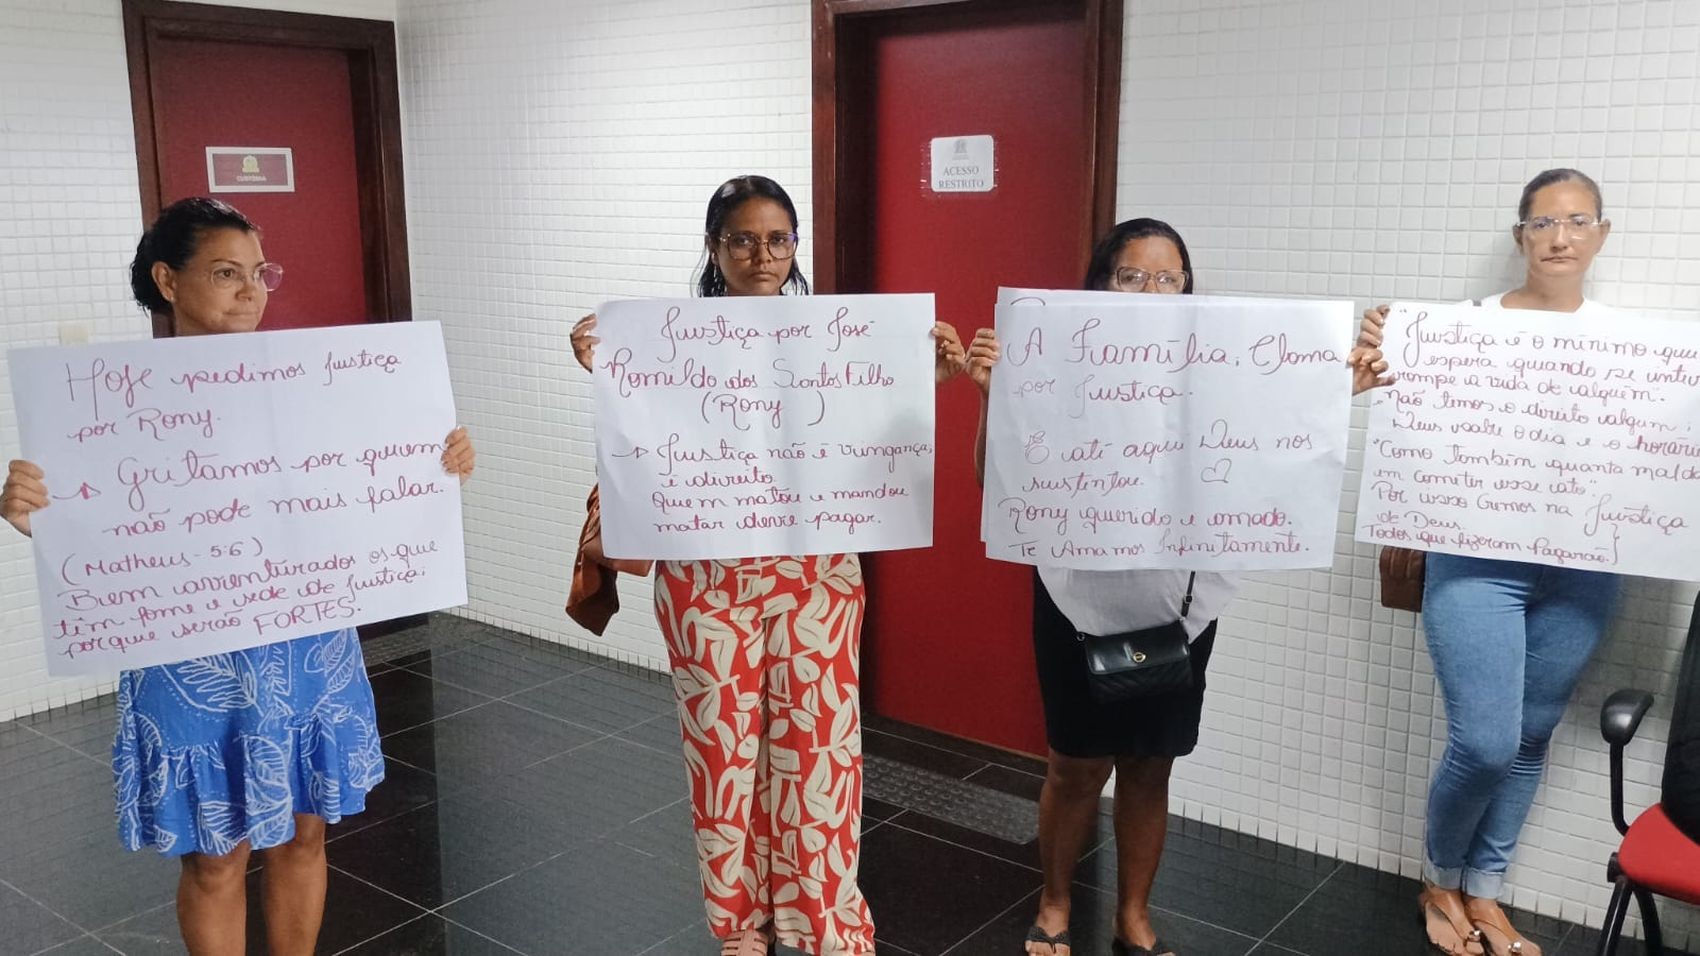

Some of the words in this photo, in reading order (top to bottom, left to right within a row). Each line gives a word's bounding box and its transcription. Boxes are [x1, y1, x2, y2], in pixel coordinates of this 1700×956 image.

[938, 179, 984, 188] RESTRITO
[943, 166, 980, 176] ACESSO
[657, 306, 764, 363] Justiça
[768, 324, 812, 345] por
[827, 306, 875, 352] José
[1006, 326, 1042, 366] A
[1505, 330, 1527, 346] é
[1553, 334, 1648, 357] mínimo
[600, 347, 717, 398] Romildo
[725, 369, 758, 389] dos
[772, 358, 842, 389] Santos
[846, 361, 895, 387] Filho
[1392, 371, 1456, 390] rompe
[1464, 375, 1480, 388] a
[1485, 375, 1530, 391] vida
[1537, 379, 1561, 396] de
[1424, 355, 1497, 371] espera
[1506, 358, 1597, 379] quando
[1603, 368, 1636, 380] se
[66, 358, 152, 421] Hoje
[171, 363, 306, 393] pedimos
[1013, 377, 1056, 397] por
[1068, 374, 1193, 419] Justiça.
[1433, 391, 1494, 411] temos
[1498, 402, 1516, 413] o
[1521, 401, 1590, 424] direito
[67, 422, 119, 443] por
[126, 407, 221, 441] Rony.
[1061, 438, 1113, 462] até
[1123, 439, 1184, 464] aqui
[1200, 419, 1259, 450] Deus
[1276, 433, 1313, 450] nos
[1392, 412, 1443, 432] Deus
[1451, 418, 1503, 437] sabe
[1528, 428, 1565, 444] dia
[1576, 438, 1591, 446] e
[1602, 439, 1620, 450] o
[657, 432, 758, 476] Justiça
[767, 442, 807, 460] não
[812, 443, 830, 459] é
[1545, 459, 1624, 476] quanta
[117, 449, 282, 512] Gritamos
[291, 452, 347, 473] por
[356, 443, 446, 476] quem
[661, 474, 679, 488] é
[1373, 469, 1404, 481] em
[1494, 479, 1542, 492] esse
[102, 508, 170, 536] não
[178, 498, 251, 533] pode
[268, 488, 347, 514] mais
[356, 475, 445, 513] falar.
[652, 491, 729, 515] Quem
[734, 486, 801, 506] matou
[810, 493, 825, 502] e
[831, 483, 909, 500] mandou
[997, 496, 1069, 536] Rony
[1079, 505, 1172, 534] querido
[1180, 513, 1195, 526] e
[1207, 507, 1292, 528] amado.
[1371, 480, 1408, 503] Por
[1419, 487, 1468, 508] isso
[1545, 503, 1574, 517] na
[1583, 493, 1688, 536] Justiça
[653, 514, 725, 533] matar
[736, 512, 799, 530] deve
[805, 511, 881, 535] pagar.
[1377, 511, 1400, 525] de
[1008, 539, 1041, 557] Te
[1154, 527, 1309, 557] Infinitamente.
[1361, 524, 1412, 541] Todos
[1416, 530, 1447, 548] que
[1451, 531, 1522, 551] fizeram
[57, 585, 163, 612] Bem
[369, 547, 388, 563] os
[391, 540, 438, 568] que
[130, 603, 193, 628] fome
[206, 599, 221, 611] e
[232, 586, 289, 607] sede
[297, 579, 335, 598] de
[171, 608, 244, 638] serão
[253, 596, 362, 635] FORTES.
